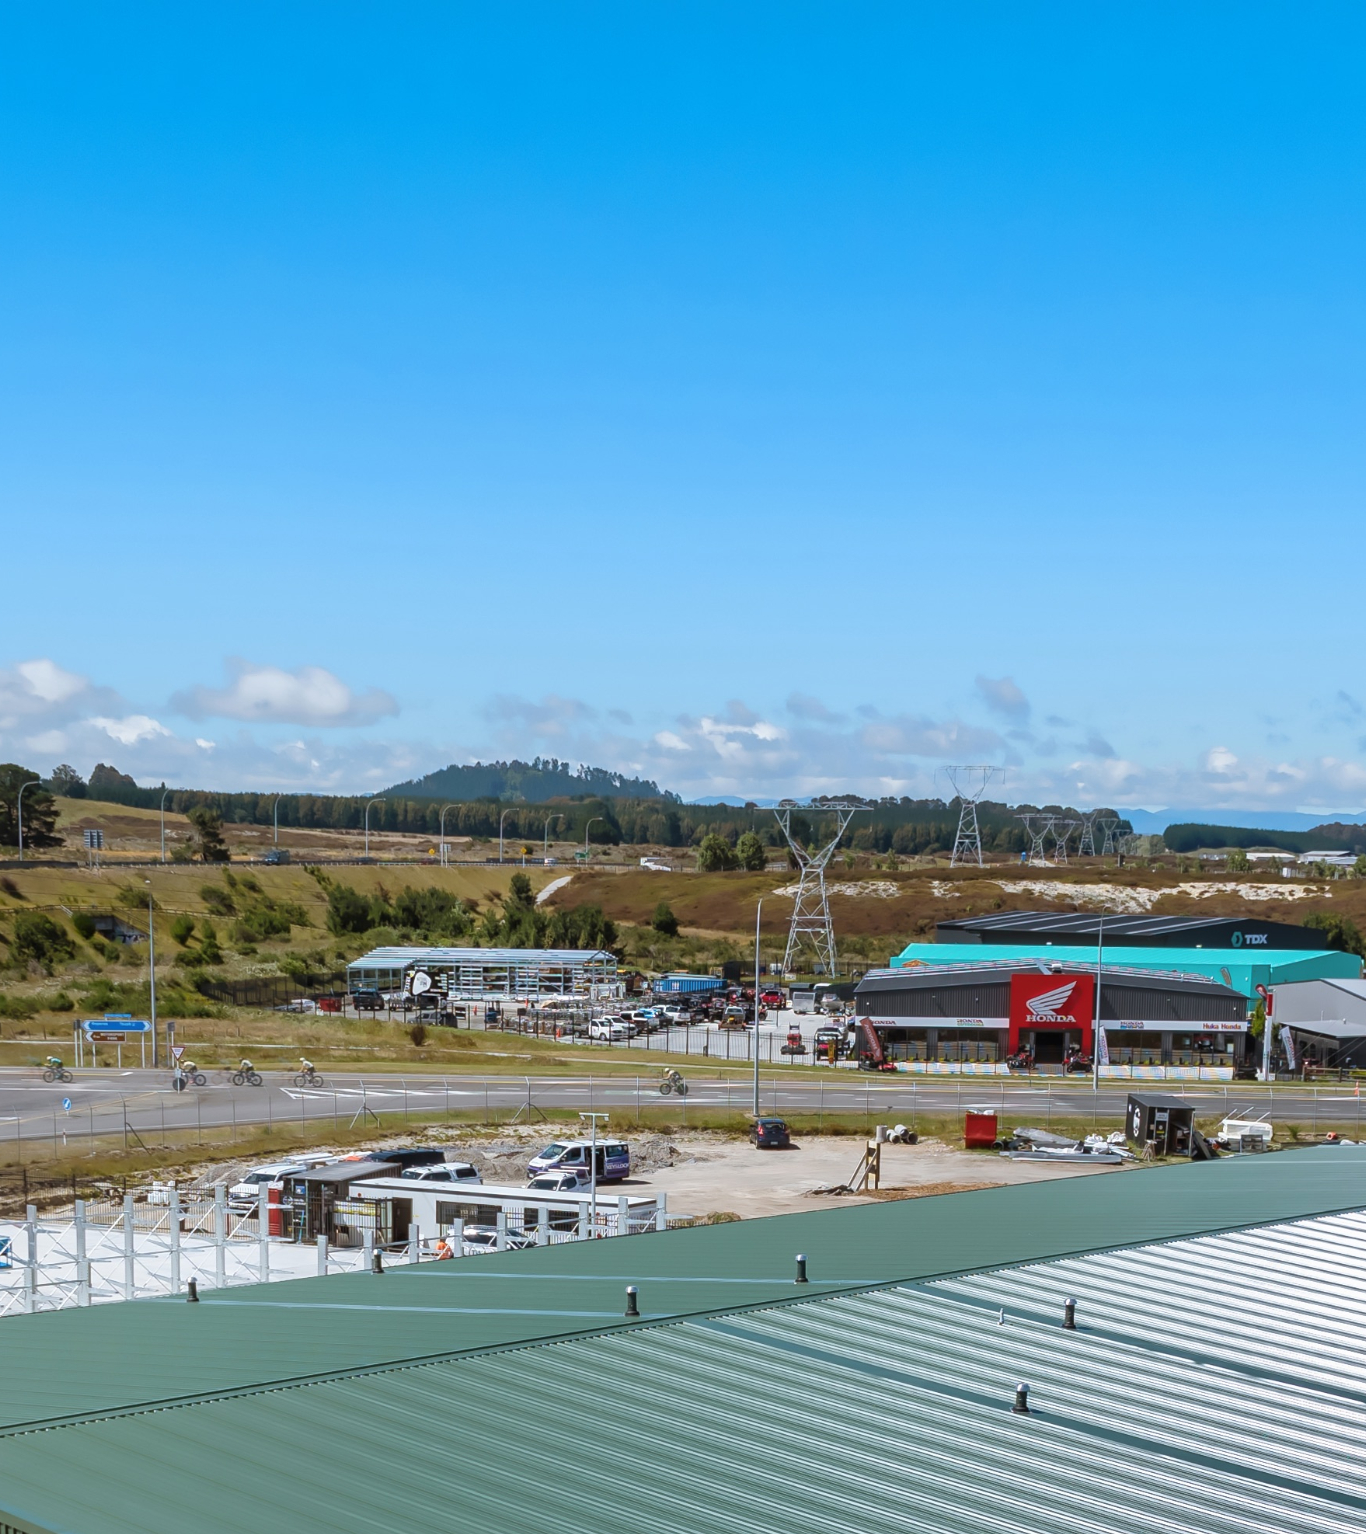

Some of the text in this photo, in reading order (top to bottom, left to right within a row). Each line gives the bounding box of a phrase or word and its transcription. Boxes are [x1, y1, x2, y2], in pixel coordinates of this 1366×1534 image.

[1244, 933, 1268, 945] TDX
[1025, 1013, 1077, 1023] HONDA
[1221, 1022, 1241, 1030] Honda
